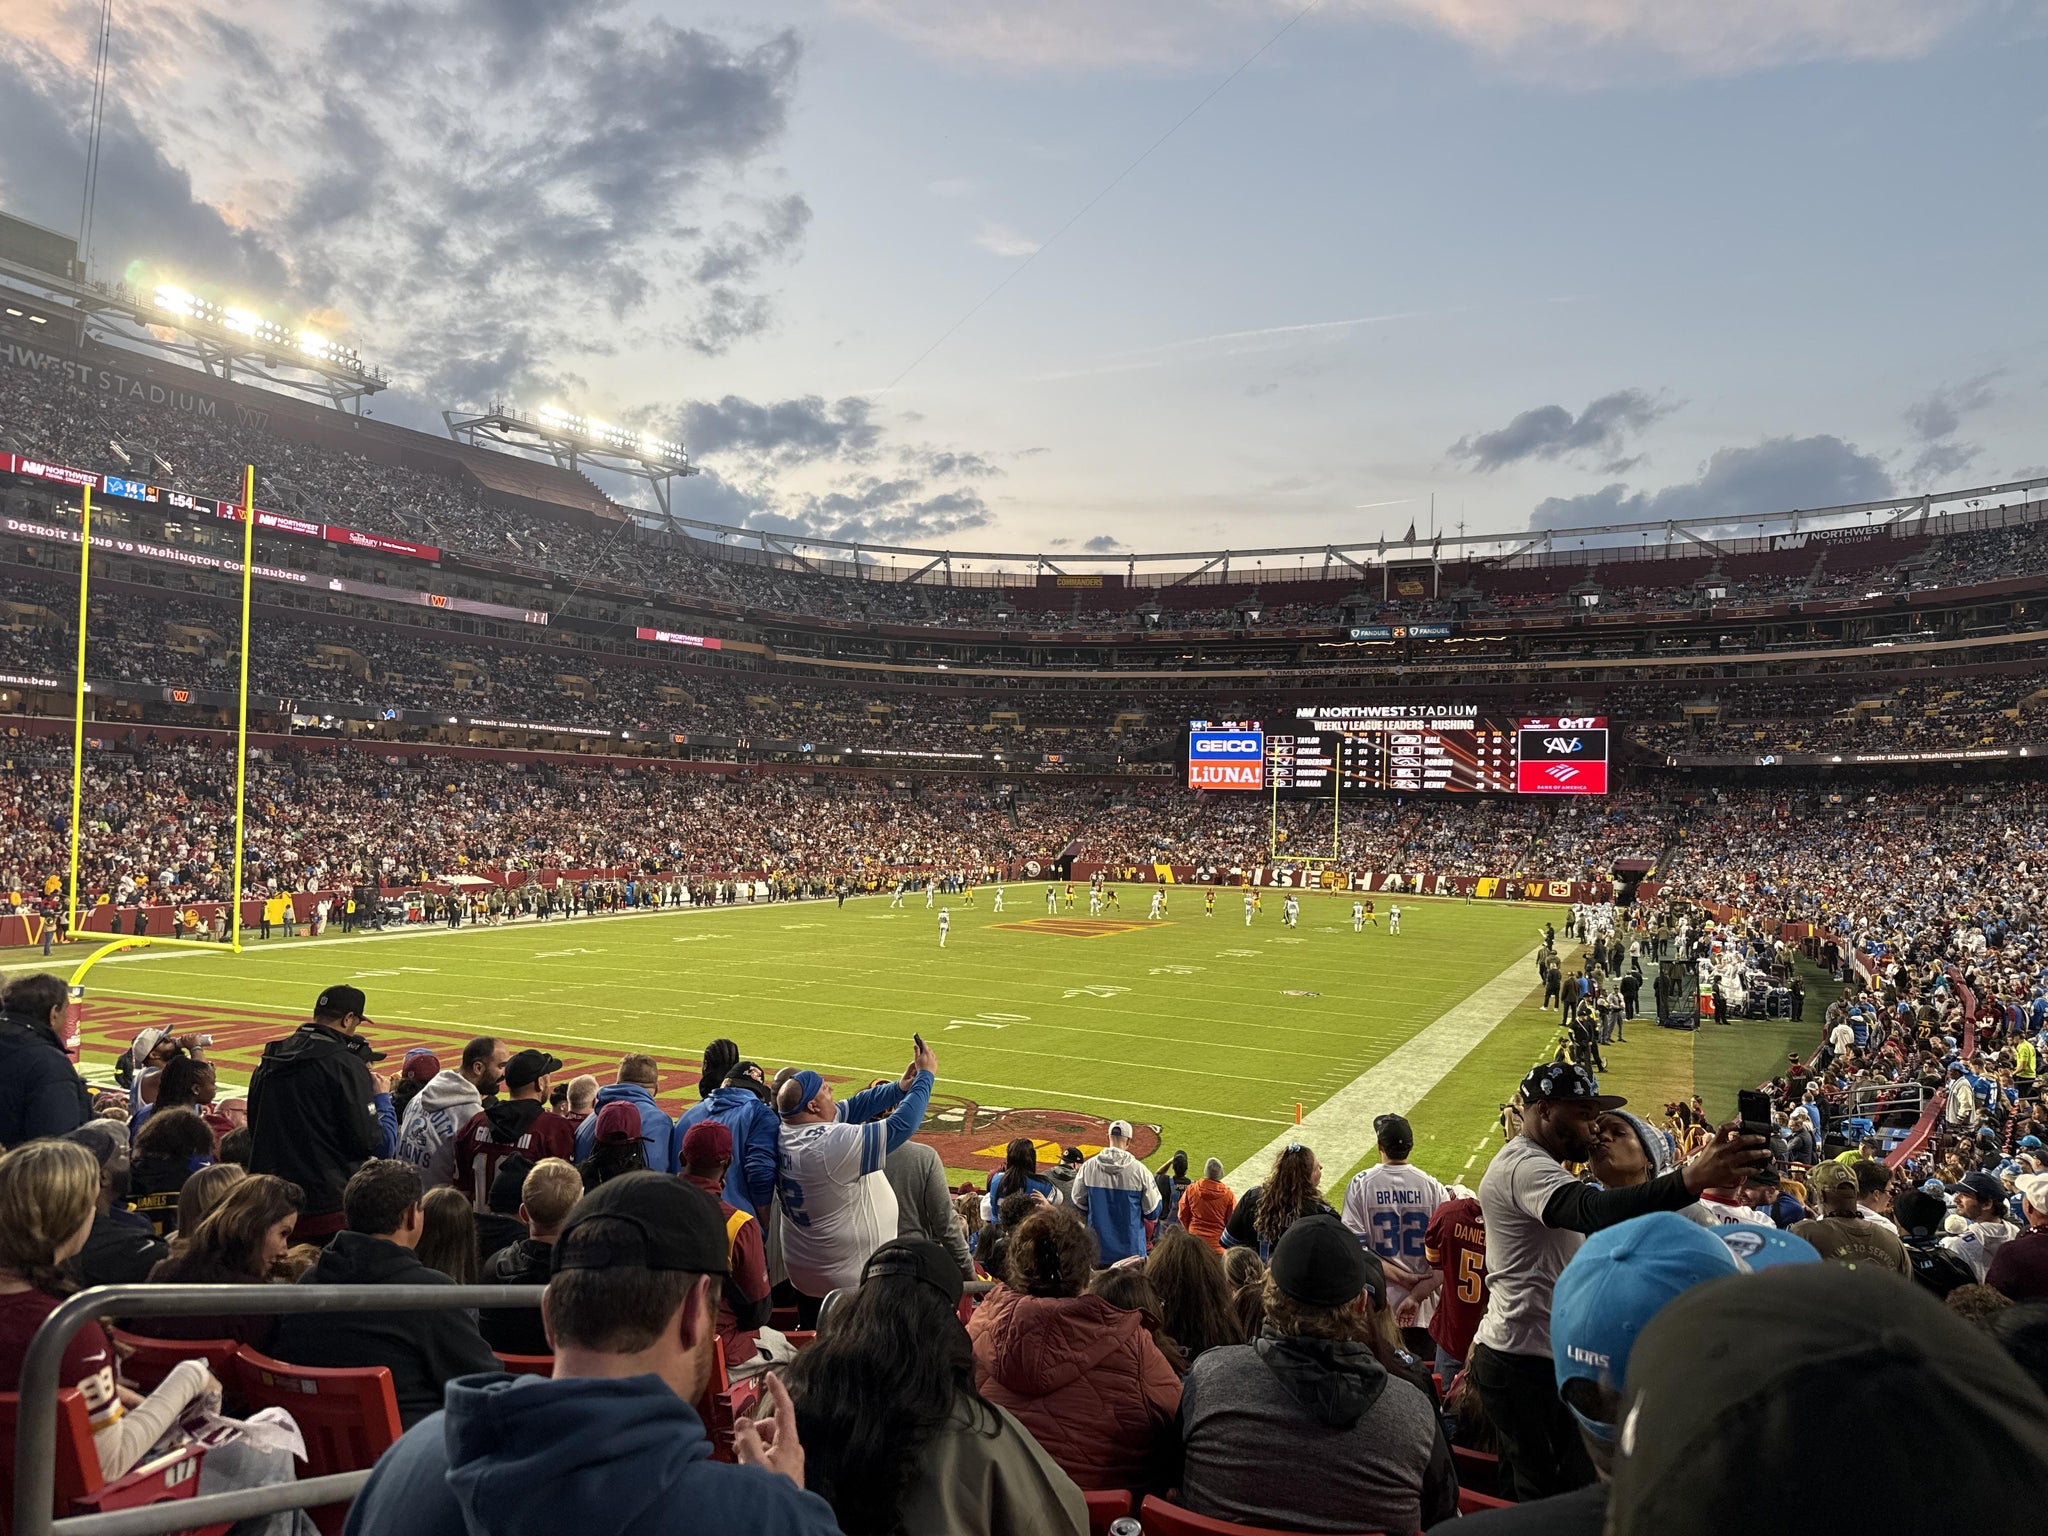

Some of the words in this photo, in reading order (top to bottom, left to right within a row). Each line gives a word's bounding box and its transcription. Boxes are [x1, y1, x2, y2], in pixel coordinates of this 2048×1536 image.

[99, 371, 217, 418] STADIUM
[46, 465, 98, 484] NORTHWEST
[125, 482, 138, 495] 14
[168, 493, 194, 509] 1:54
[226, 505, 234, 515] 3
[277, 518, 319, 532] NORTHWEST
[1811, 525, 1887, 540] NORTHWEST
[1826, 535, 1871, 546] STADIUM
[117, 541, 133, 552] vs
[137, 543, 220, 568] Washington
[1056, 577, 1103, 589] COMMANDERS
[1419, 627, 1450, 635] FANDUEL
[671, 633, 704, 643] NORTHWEST
[1334, 667, 1389, 676] CHAMPIONS
[1320, 707, 1407, 717] NORTHWEST
[1409, 705, 1478, 716] STADIUM
[1314, 721, 1348, 731] WEEKLY
[1349, 721, 1383, 731] LEAGUE
[1384, 720, 1424, 731] LEADERS
[1431, 719, 1474, 730] RUSHING
[1558, 717, 1596, 729] 0:17
[1196, 739, 1258, 752] GEICO
[1297, 737, 1320, 745] TAYLOR
[1424, 736, 1440, 744] HALL
[1191, 765, 1261, 783] LiUNA!
[1062, 984, 1132, 999] 20
[944, 1012, 1031, 1031] 10
[1918, 1026, 1931, 1039] 22
[393, 1139, 431, 1168] IONS
[1376, 1190, 1422, 1204] BRANCH
[1372, 1211, 1430, 1258] 32
[1454, 1223, 1486, 1246] DANIE
[1457, 1247, 1484, 1304] 5
